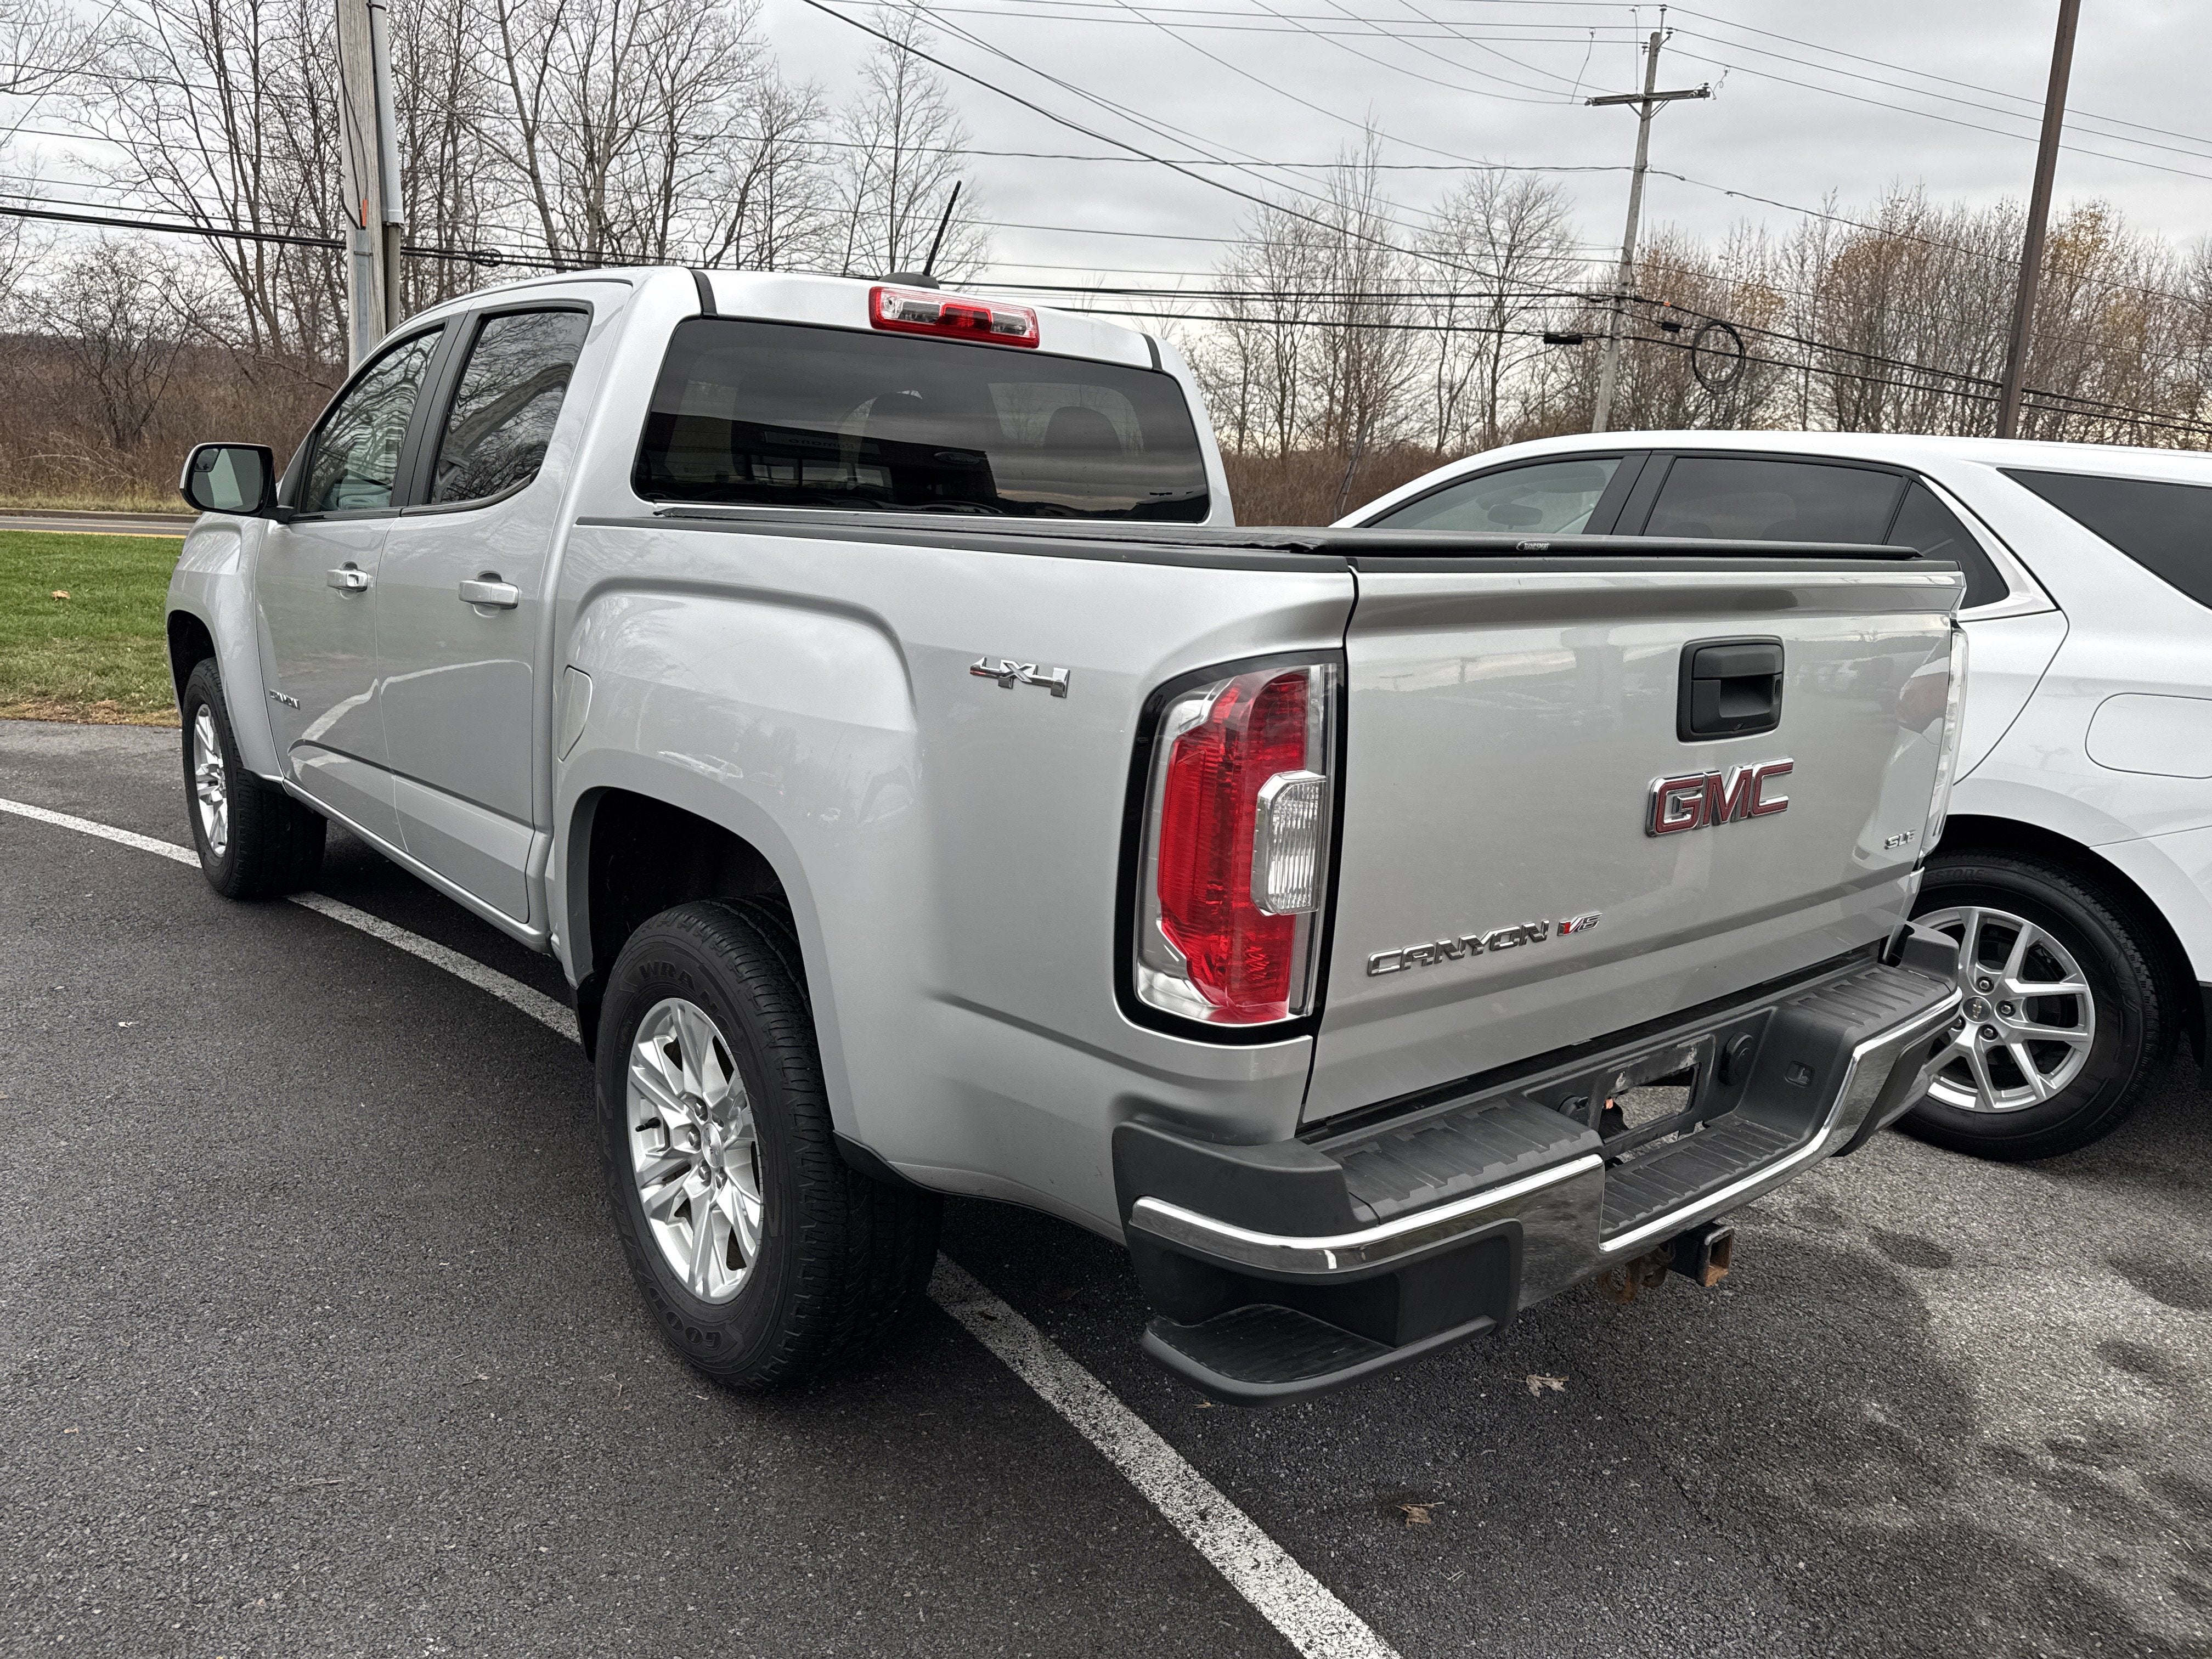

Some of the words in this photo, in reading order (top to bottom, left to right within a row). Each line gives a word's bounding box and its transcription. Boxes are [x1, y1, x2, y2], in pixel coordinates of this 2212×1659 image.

[1646, 757, 1794, 837] GMC
[1884, 829, 1917, 850] SLE
[1367, 920, 1550, 977] CANYON
[1557, 912, 1603, 936] V6
